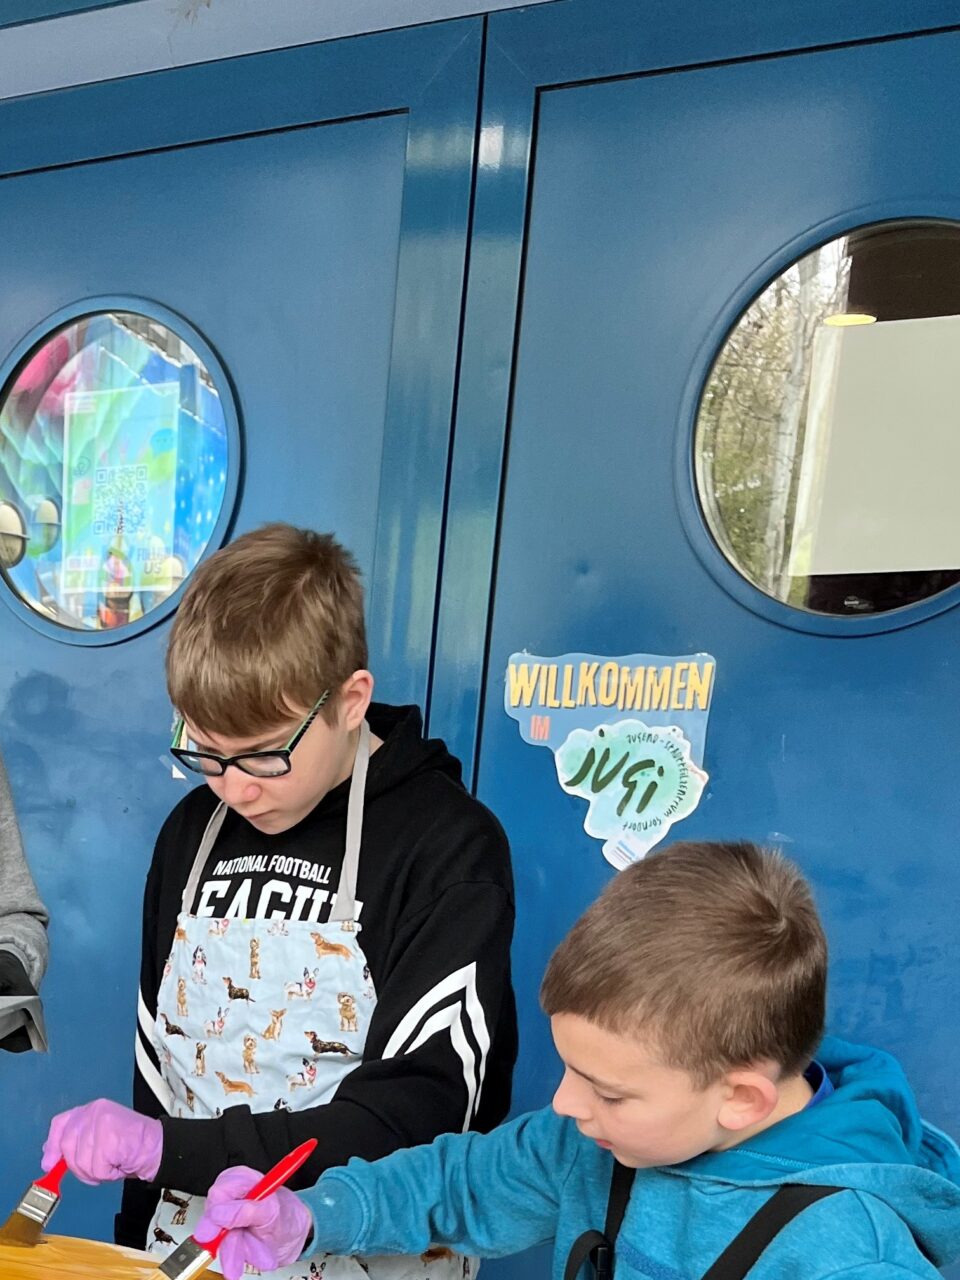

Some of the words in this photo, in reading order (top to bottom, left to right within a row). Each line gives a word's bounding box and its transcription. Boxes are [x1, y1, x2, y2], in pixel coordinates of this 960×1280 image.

[509, 662, 713, 711] WILLKOMMEN
[213, 855, 267, 875] NATIONAL
[267, 854, 332, 884] FOOTBALL
